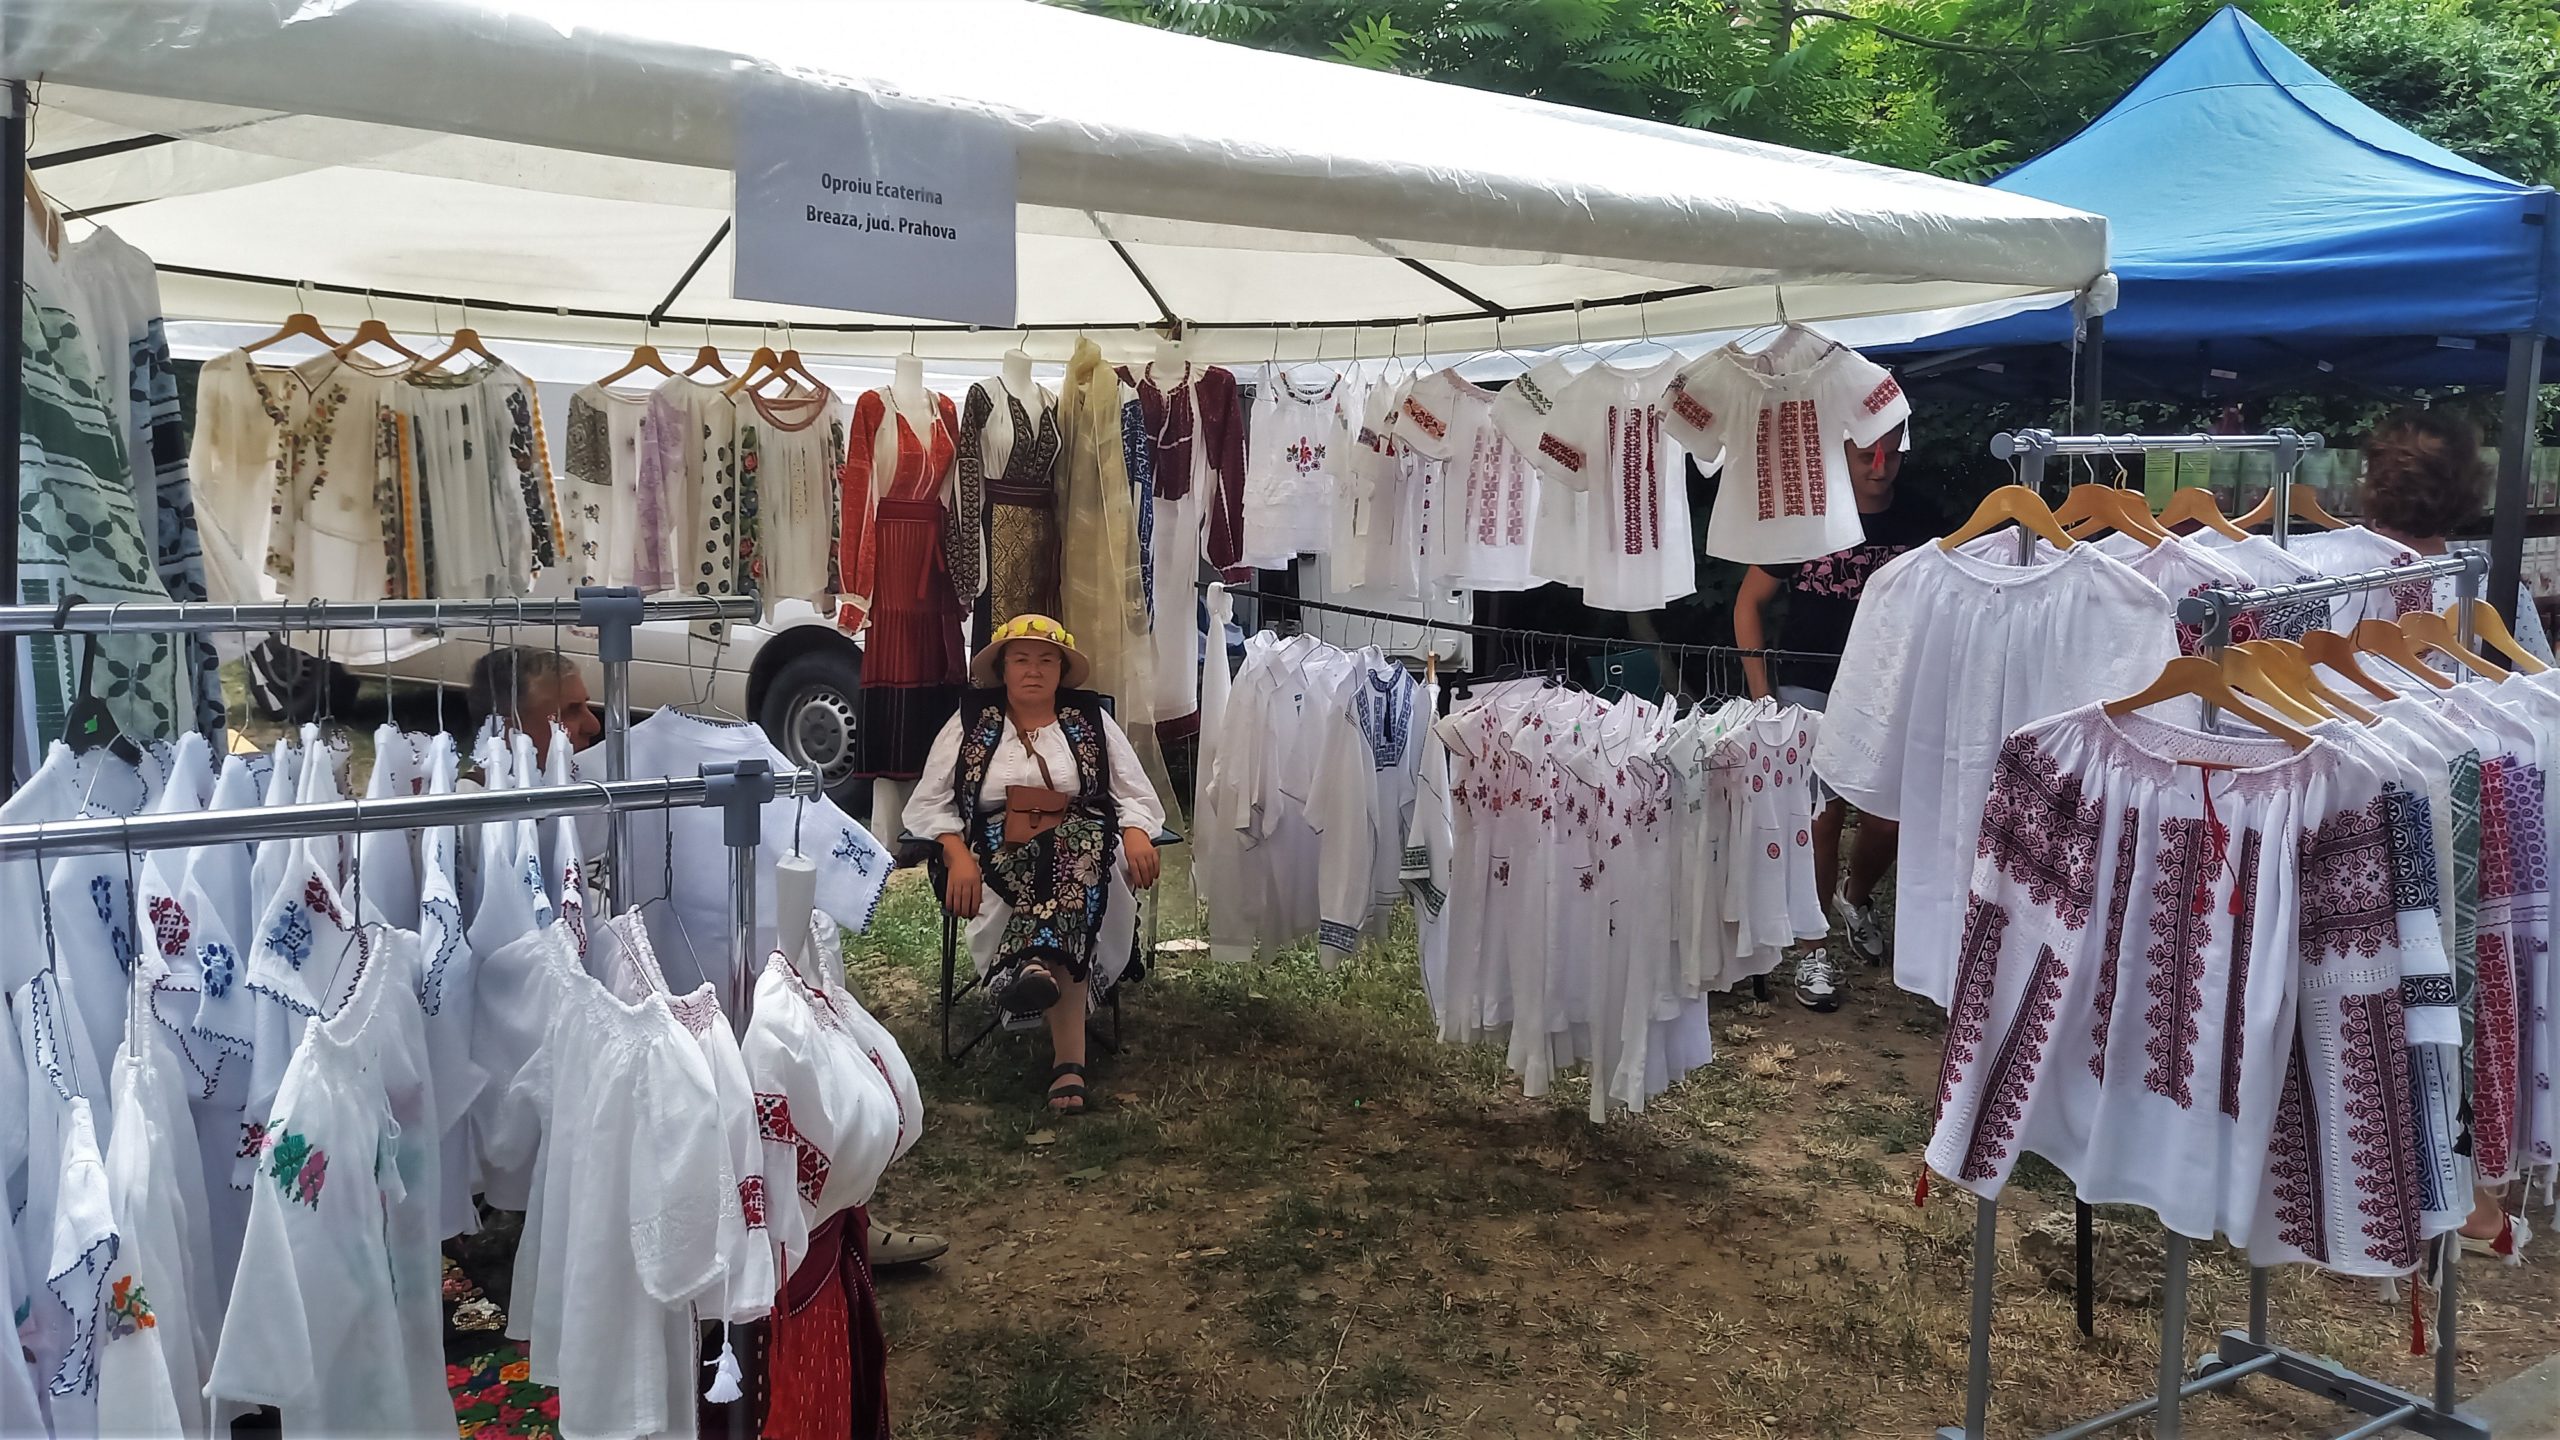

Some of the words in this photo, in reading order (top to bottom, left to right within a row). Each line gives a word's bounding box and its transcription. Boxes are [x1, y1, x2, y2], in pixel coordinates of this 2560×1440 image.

[821, 172, 872, 195] Oproiu
[875, 180, 943, 205] Ecaterina
[806, 204, 863, 231] Breaza,
[865, 212, 895, 233] jud.
[898, 216, 957, 240] Prahova
